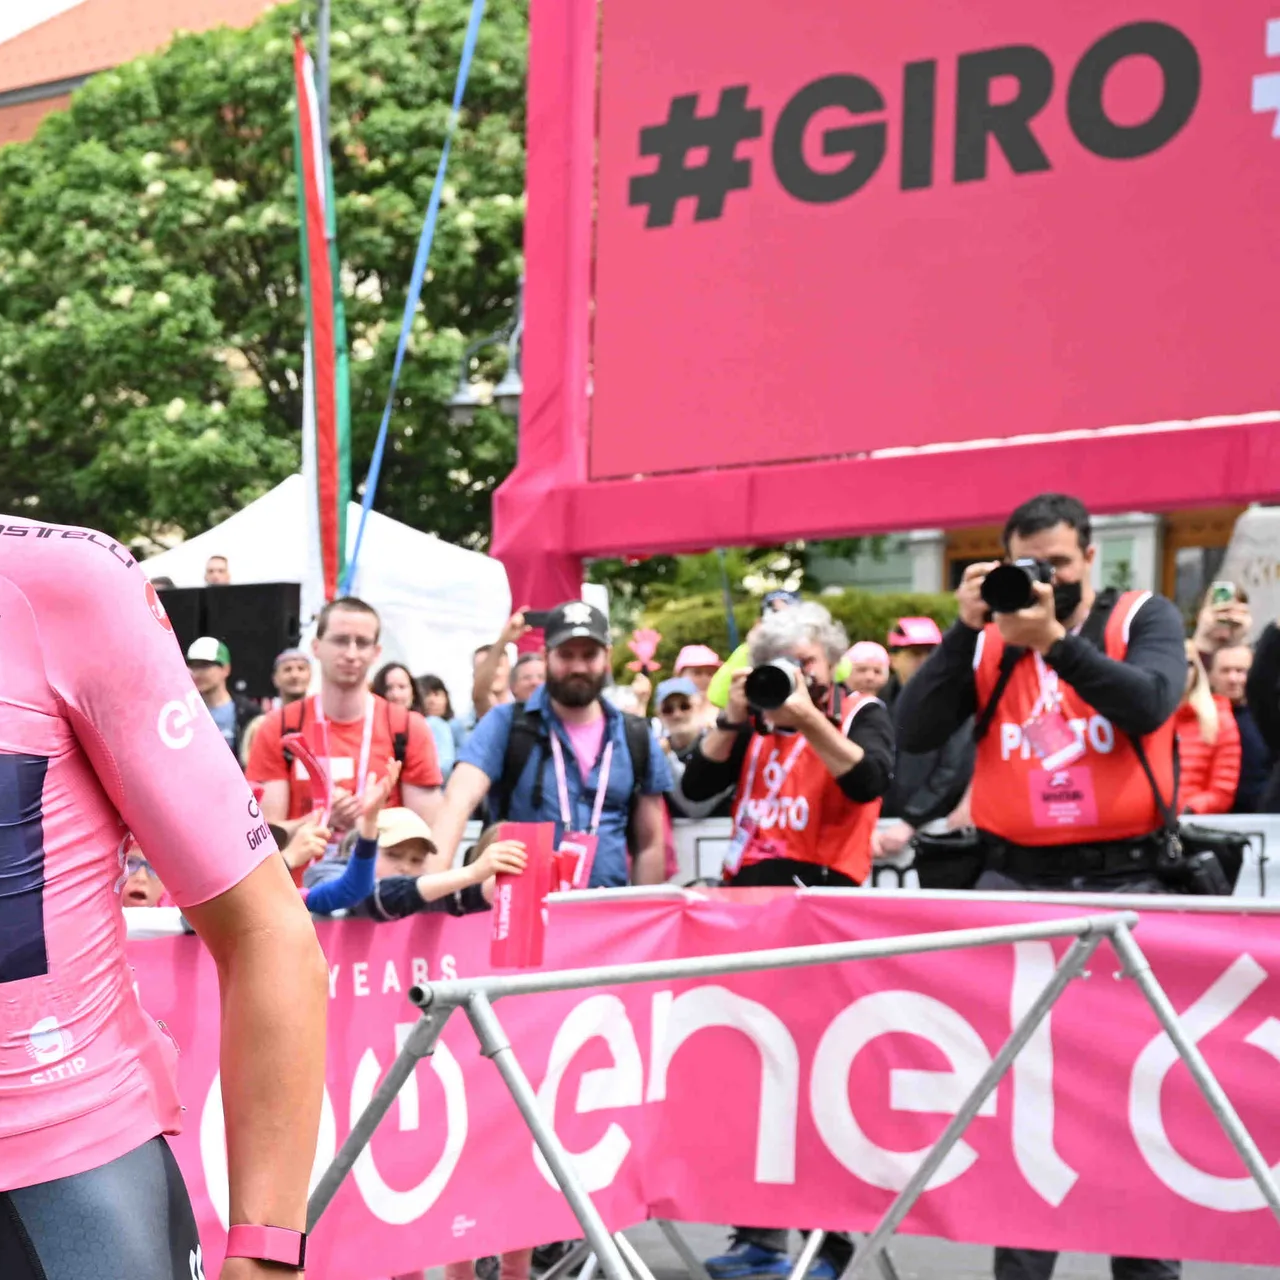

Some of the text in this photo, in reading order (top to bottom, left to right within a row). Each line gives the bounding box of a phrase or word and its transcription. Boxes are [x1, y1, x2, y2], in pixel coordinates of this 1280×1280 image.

[628, 20, 1202, 229] #GIRO
[1001, 714, 1116, 761] PTO
[531, 940, 1080, 1209] enel
